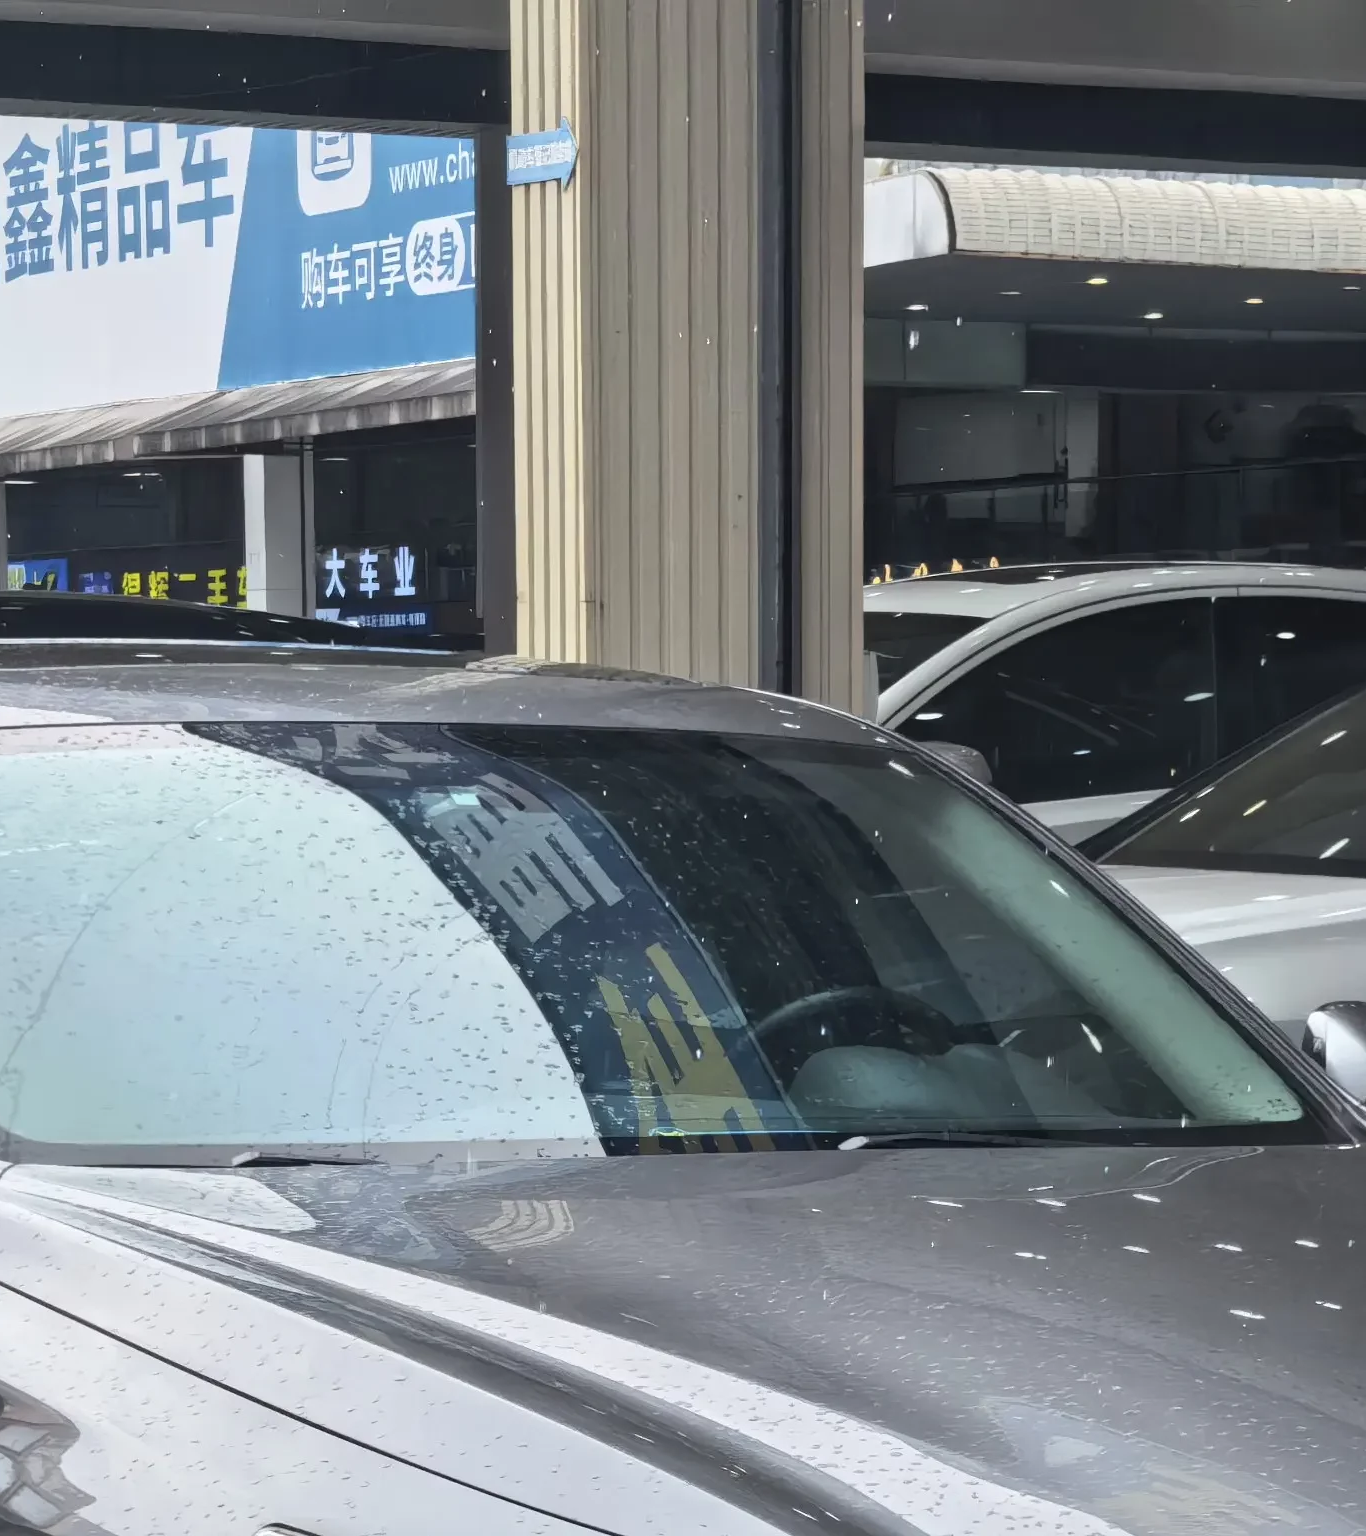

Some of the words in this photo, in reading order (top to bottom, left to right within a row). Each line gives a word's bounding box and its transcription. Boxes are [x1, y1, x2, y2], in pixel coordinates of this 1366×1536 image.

[301, 227, 475, 309] 购车可享终身
[325, 546, 416, 599] 大车业
